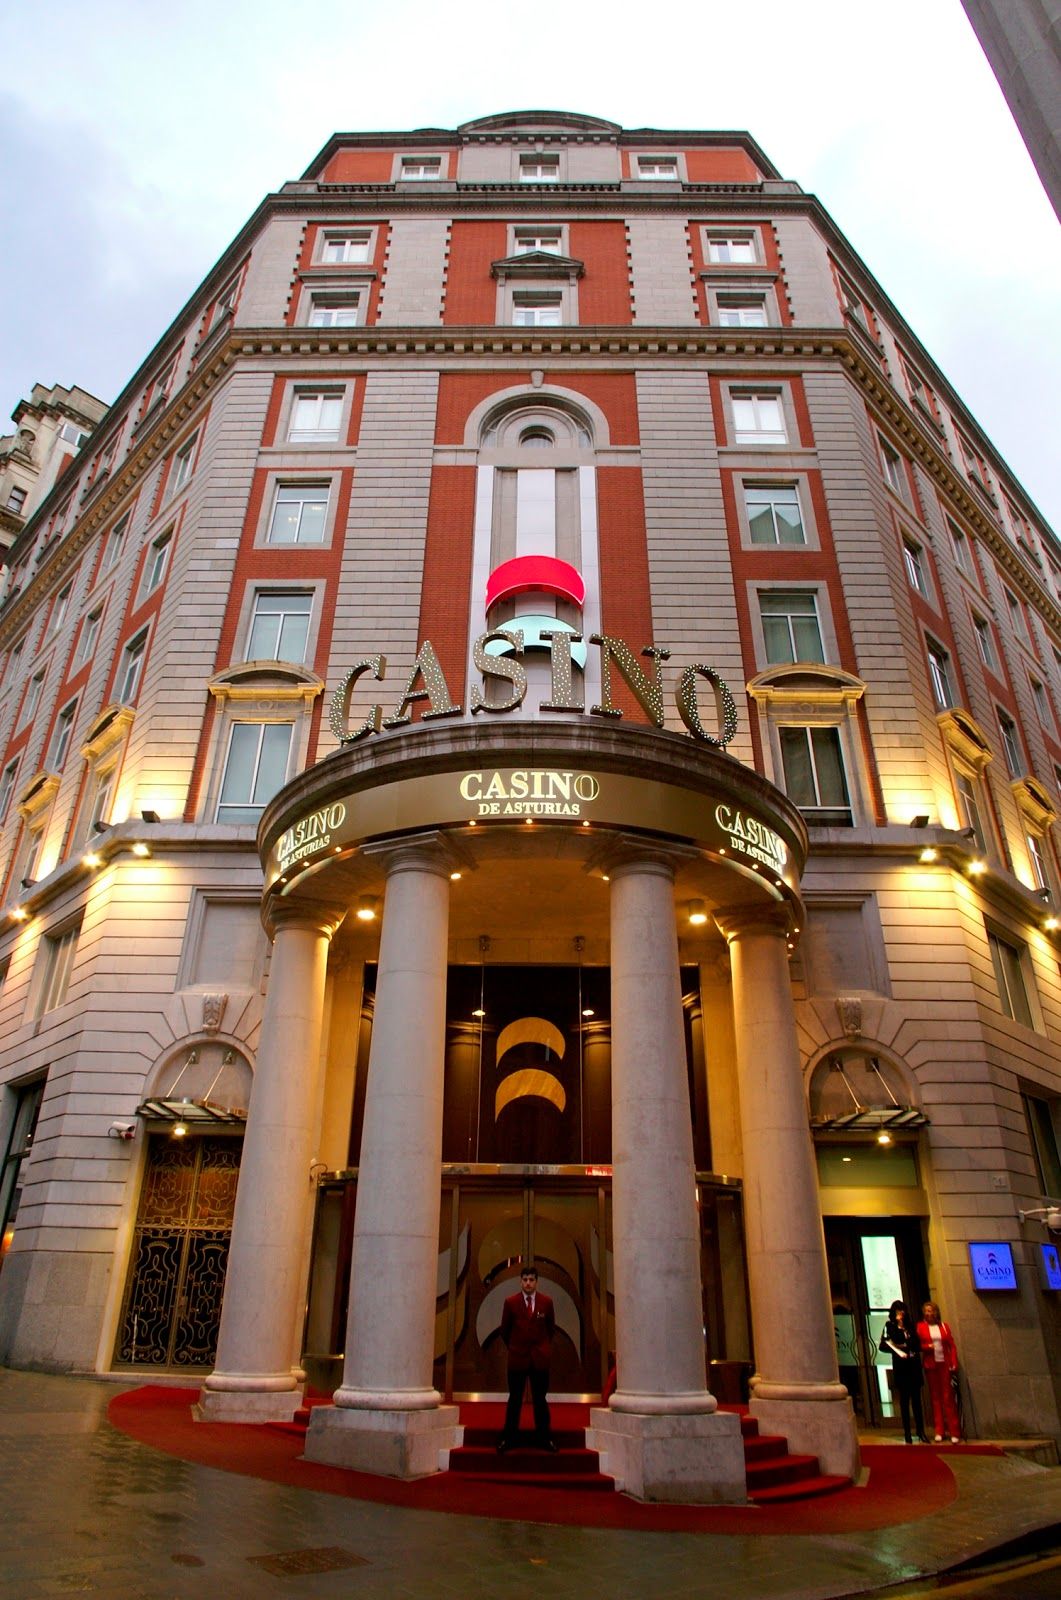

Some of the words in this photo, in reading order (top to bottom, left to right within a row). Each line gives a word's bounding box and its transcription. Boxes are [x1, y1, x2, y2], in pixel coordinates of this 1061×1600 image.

[329, 629, 738, 747] CASINO
[460, 771, 600, 801] CASINO
[478, 803, 500, 815] DE
[503, 802, 580, 816] ASTURIAS
[277, 803, 346, 861] CASINO
[715, 804, 787, 865] CASINO
[730, 836, 746, 852] DE
[289, 835, 330, 865] ASTURIAS
[977, 1267, 1011, 1276] CASINO
